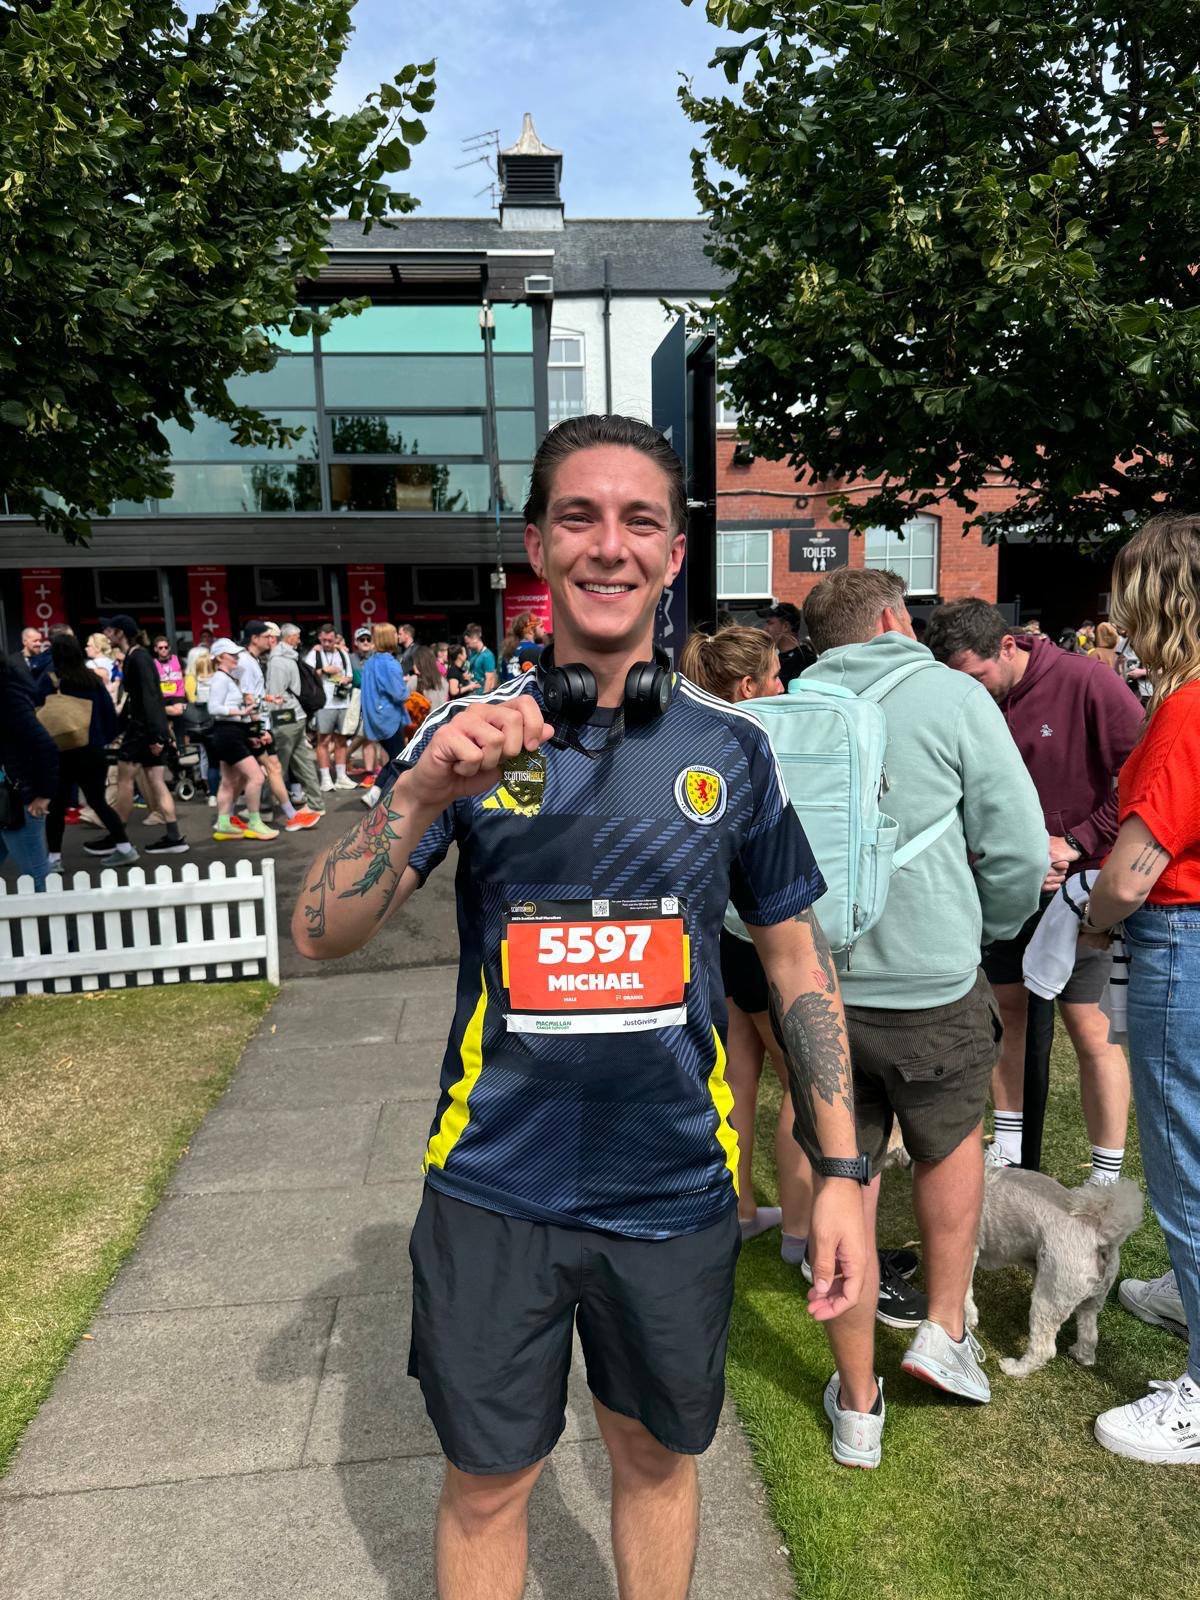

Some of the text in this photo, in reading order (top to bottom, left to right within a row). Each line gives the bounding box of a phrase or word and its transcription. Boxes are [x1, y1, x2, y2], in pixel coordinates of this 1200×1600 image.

[802, 546, 837, 558] TOILETS
[538, 925, 652, 965] 5597
[548, 972, 644, 992] MICHAEL
[622, 1017, 657, 1026] JustGiving
